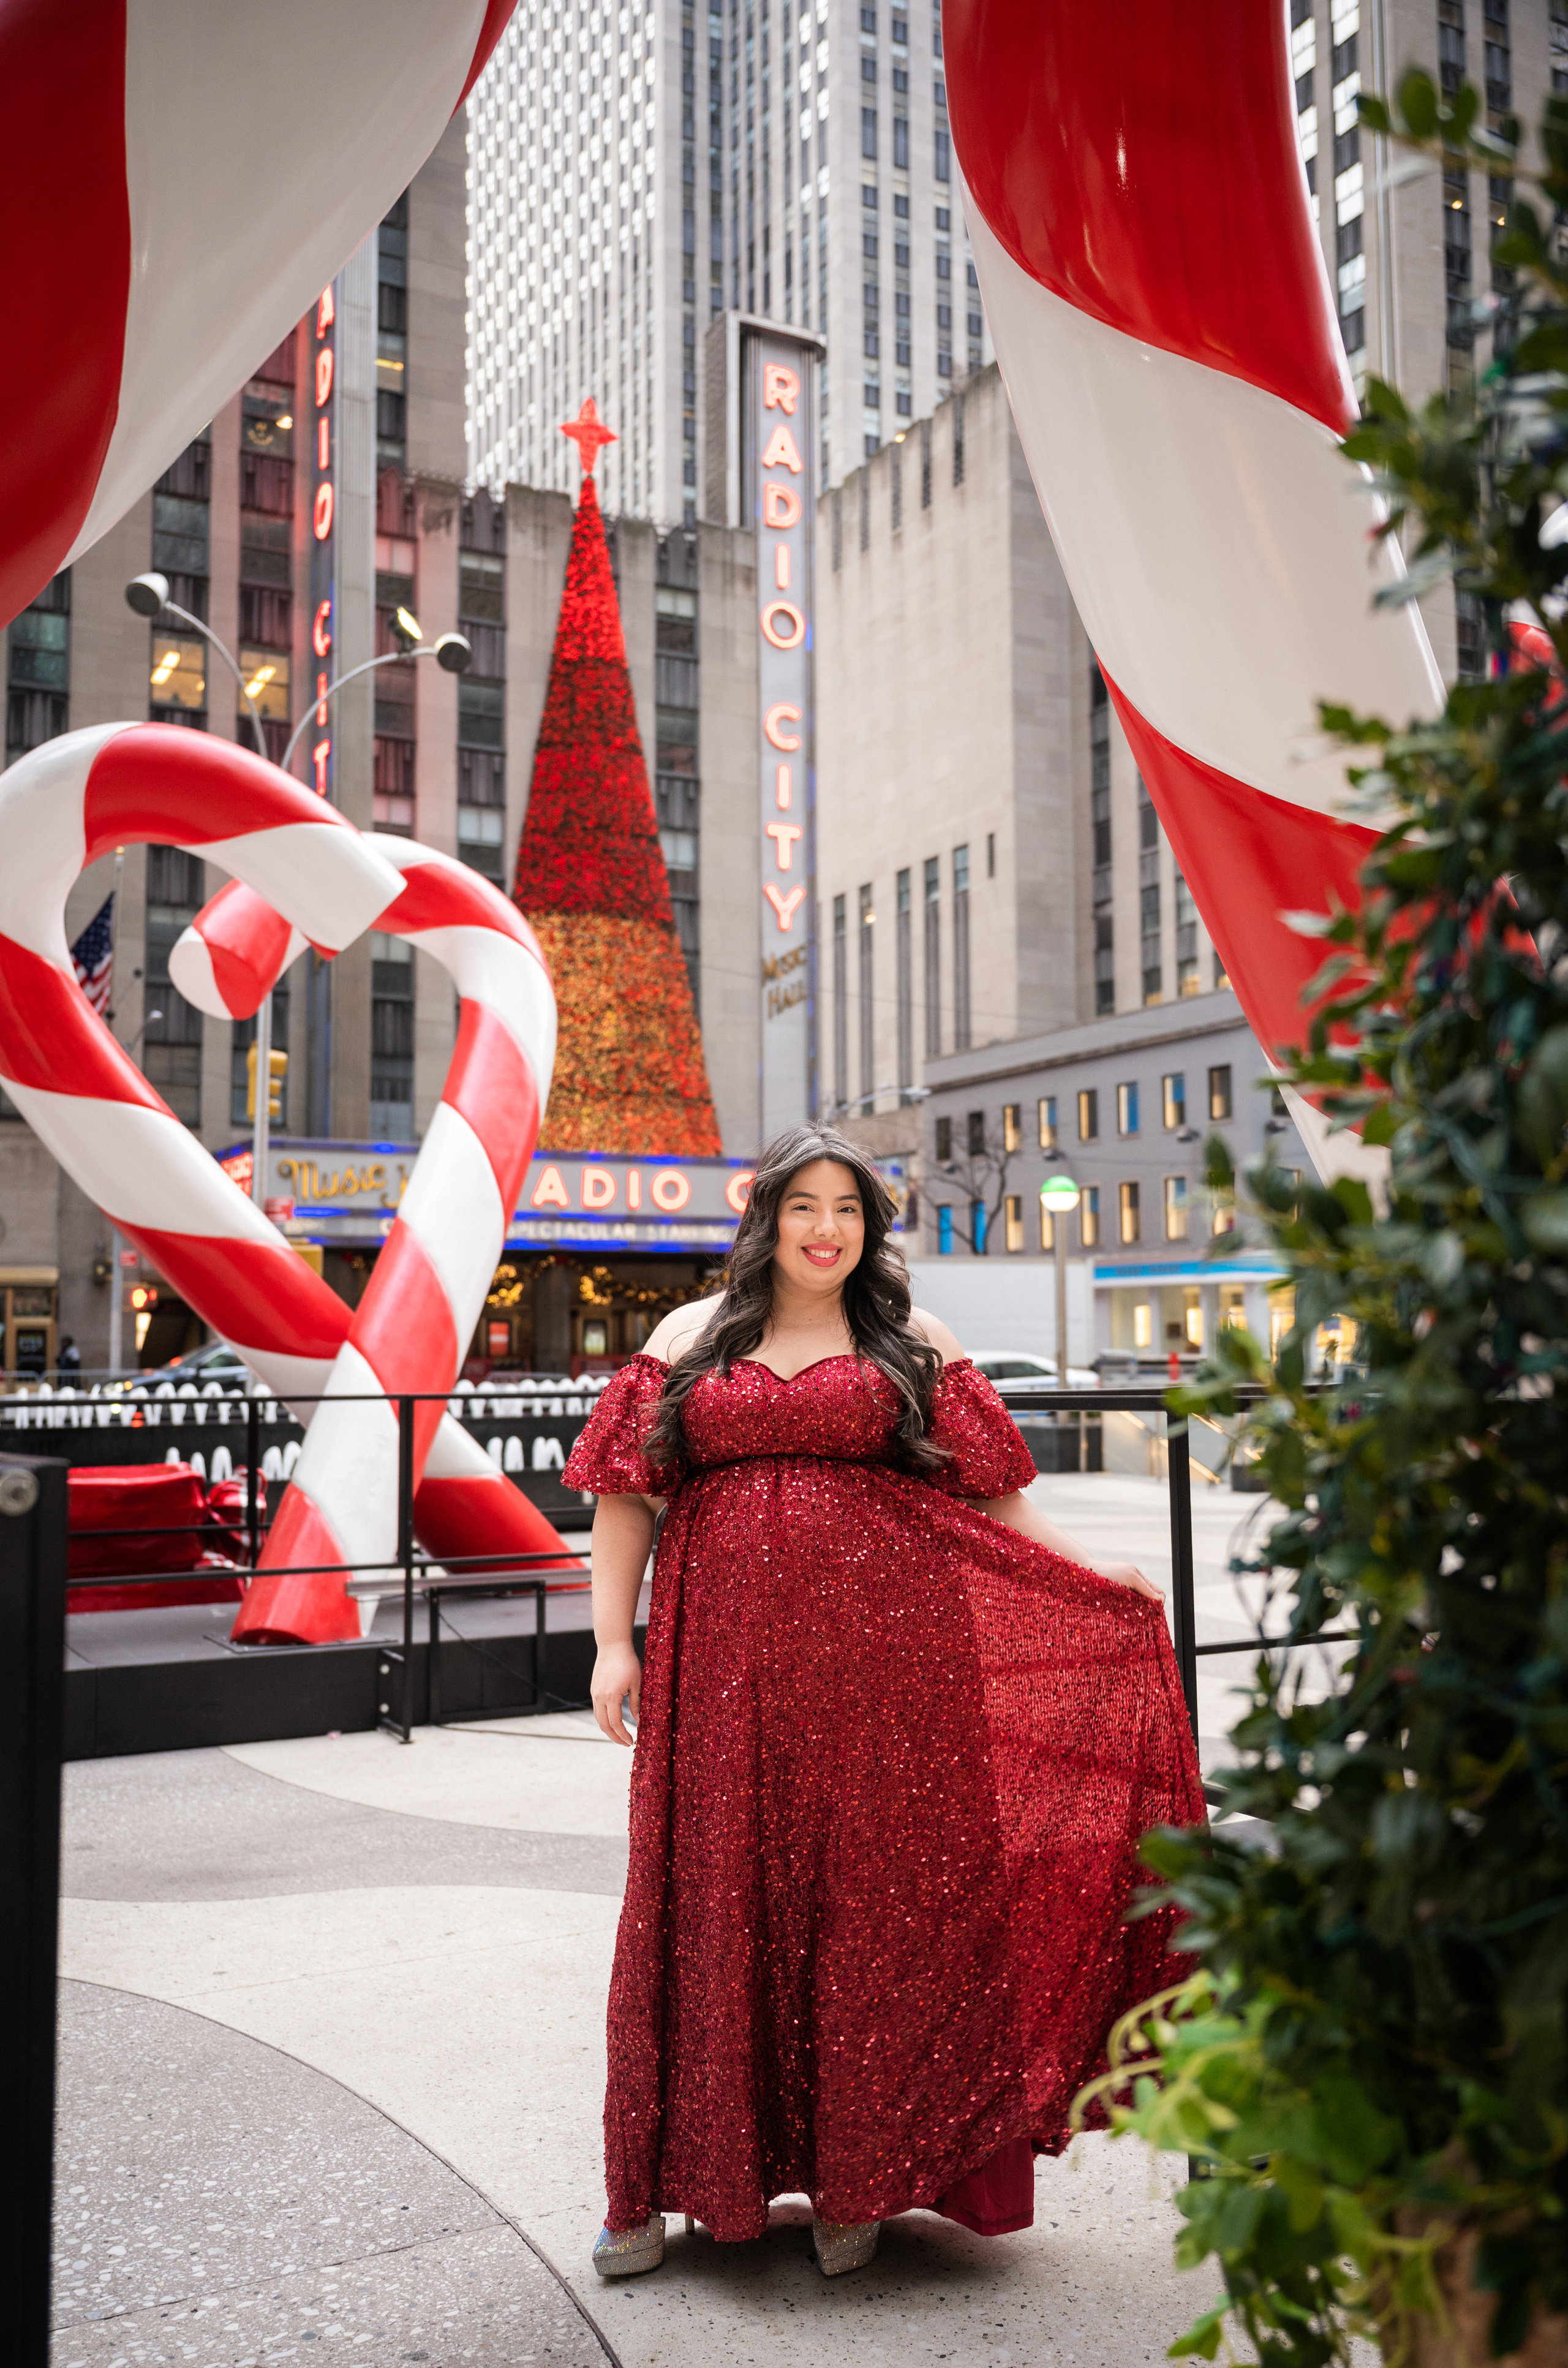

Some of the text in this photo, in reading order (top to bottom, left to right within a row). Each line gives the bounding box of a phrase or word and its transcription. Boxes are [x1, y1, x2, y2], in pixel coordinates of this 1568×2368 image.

[313, 284, 335, 796] ADIO CIT
[761, 362, 807, 931] RADIO CITY
[530, 1165, 692, 1212] ADIO
